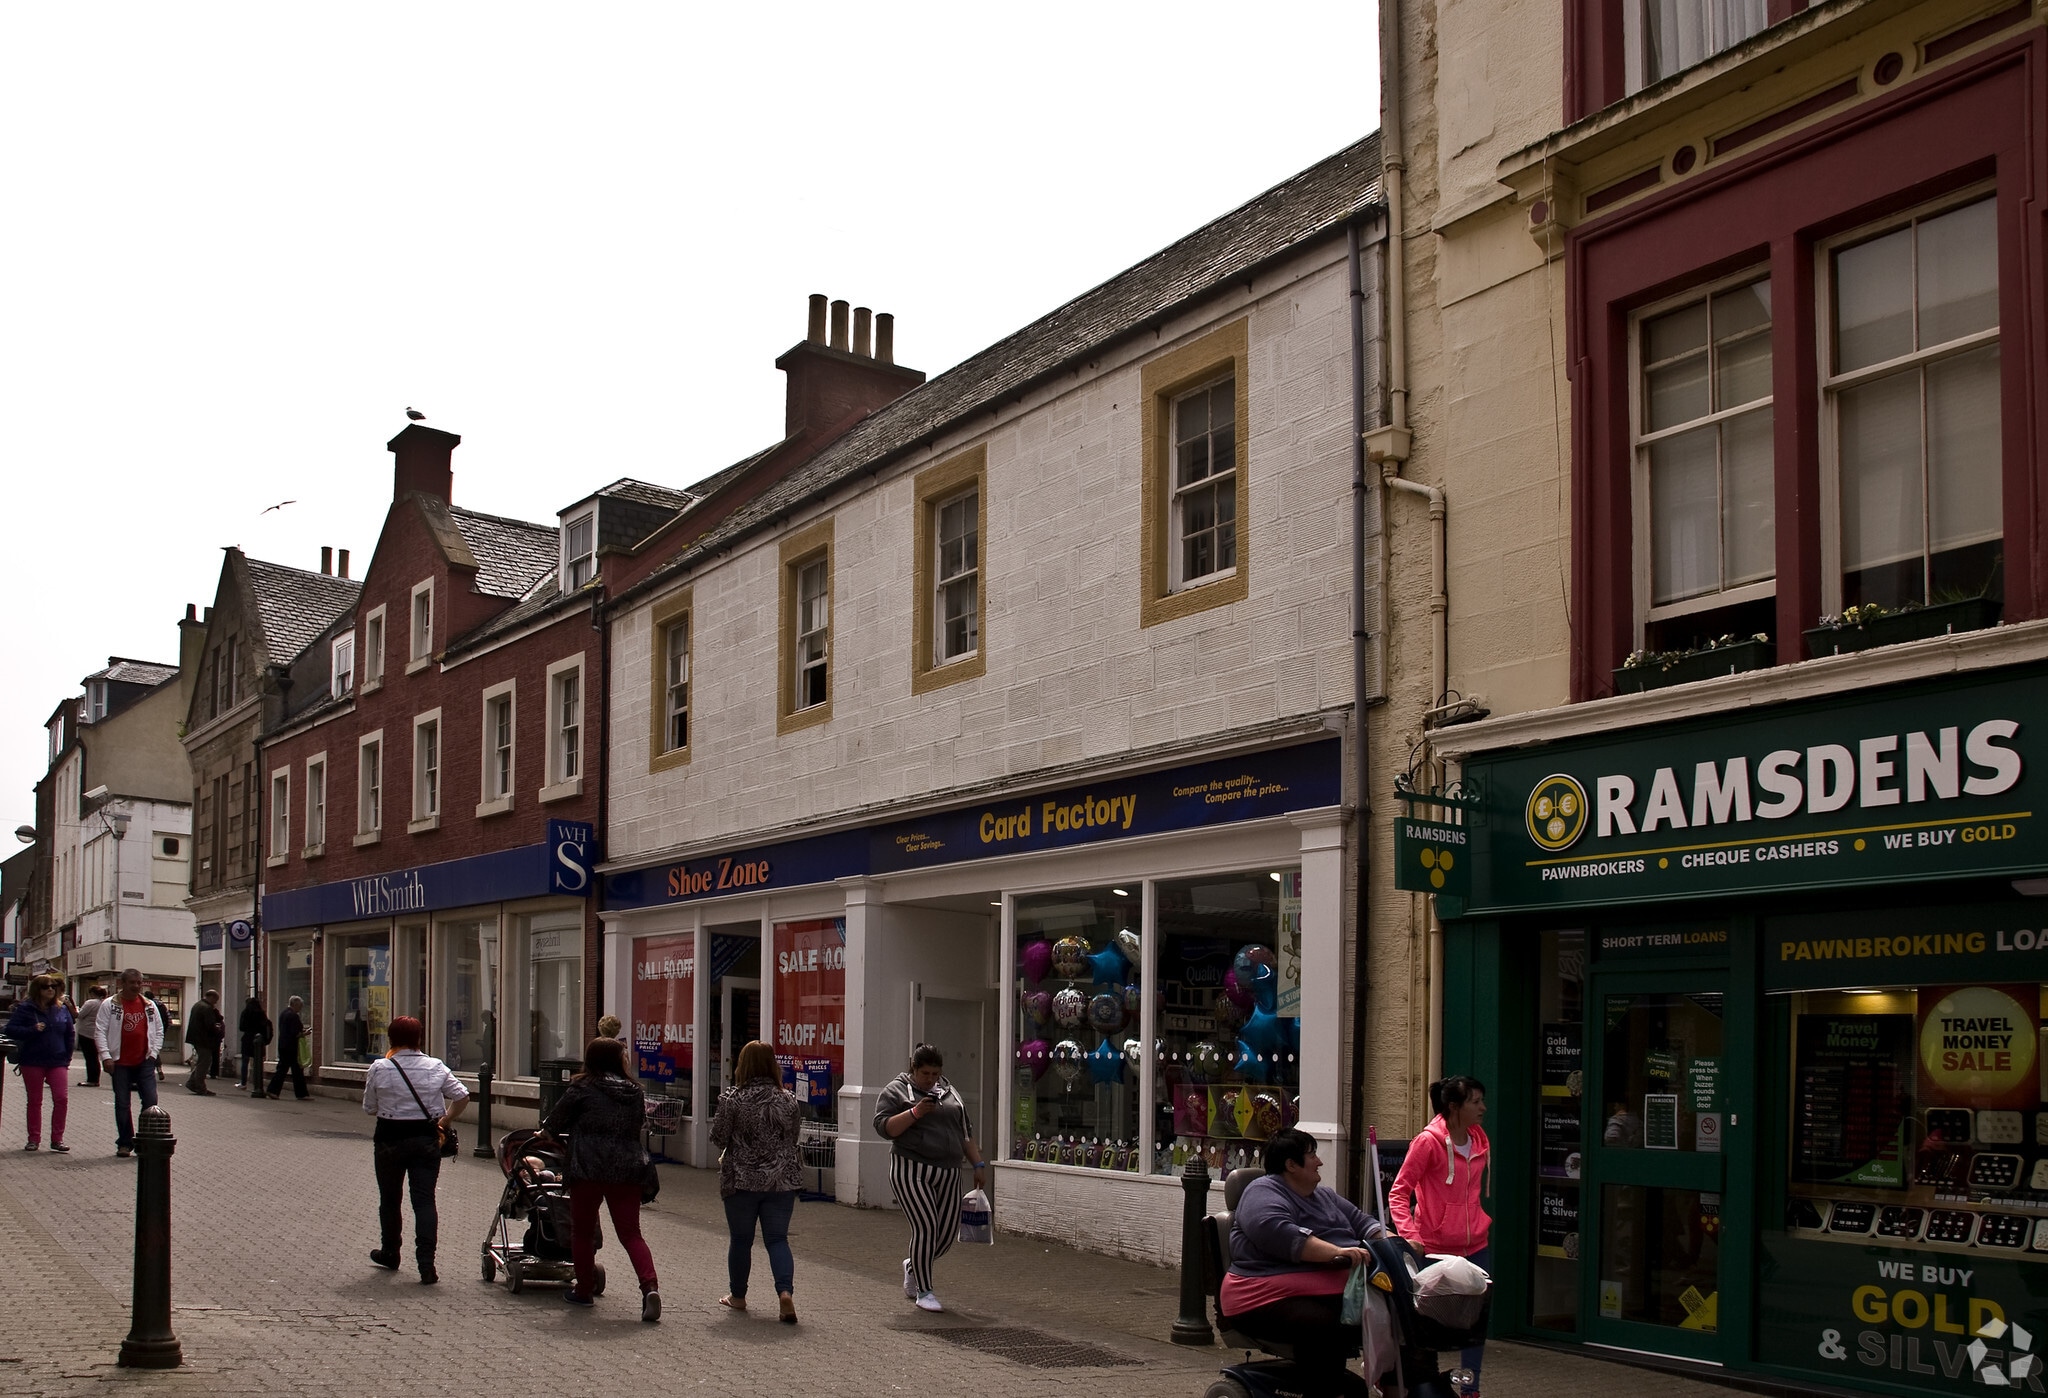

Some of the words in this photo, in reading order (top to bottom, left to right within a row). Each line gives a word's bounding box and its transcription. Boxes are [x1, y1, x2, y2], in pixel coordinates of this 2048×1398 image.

[1597, 718, 2022, 838] RAMSDENS
[1172, 783, 1208, 797] Compare
[1209, 780, 1223, 791] the
[1204, 791, 1241, 804] Compare
[1243, 786, 1257, 798] the
[979, 805, 1031, 843] Card
[1042, 794, 1137, 834] Factory
[558, 825, 587, 843] WH
[896, 835, 910, 844] Clear
[1406, 824, 1467, 845] RAMSDENS
[905, 843, 920, 852] Clear
[1542, 859, 1645, 880] PAWNBROKERS
[1681, 849, 1750, 868] CHEQUE
[1755, 840, 1839, 861] CASHERS
[1883, 833, 1913, 849] WE
[1918, 829, 1956, 847] BUY
[1961, 824, 2016, 842] GOLD
[556, 841, 587, 891] S
[668, 866, 713, 897] Shoe
[717, 857, 769, 890] Zone
[351, 870, 425, 916] WHSmith
[1601, 936, 1644, 949] SHORT
[1646, 933, 1681, 946] TERM
[1683, 930, 1728, 945] LOANS
[1781, 932, 1986, 961] PAWNBROKING
[368, 950, 377, 982] 3
[778, 949, 818, 974] SALE
[1186, 964, 1223, 986] Quality
[664, 1023, 693, 1044] SALE
[1827, 1020, 1878, 1035] Travel
[1941, 1017, 2014, 1032] TRAVEL
[1546, 1036, 1568, 1046] Gold
[1825, 1034, 1880, 1050] Money
[1943, 1035, 2012, 1049] MONEY
[1546, 1046, 1553, 1056] &
[1555, 1046, 1582, 1056] Silver
[1694, 1059, 1715, 1067] Please
[1942, 1051, 2012, 1072] SALE
[1649, 1068, 1671, 1079] OPEN
[1871, 1164, 1884, 1174] 0%
[1857, 1173, 1898, 1184] Commission
[1543, 1196, 1564, 1207] Gold
[1702, 1205, 1718, 1214] NPA
[1543, 1206, 1550, 1216] &
[1552, 1206, 1578, 1218] Silver
[1878, 1260, 1914, 1281] WE
[1922, 1265, 1974, 1288] BUY
[1851, 1283, 2006, 1339] GOLD
[1818, 1328, 1848, 1361] &
